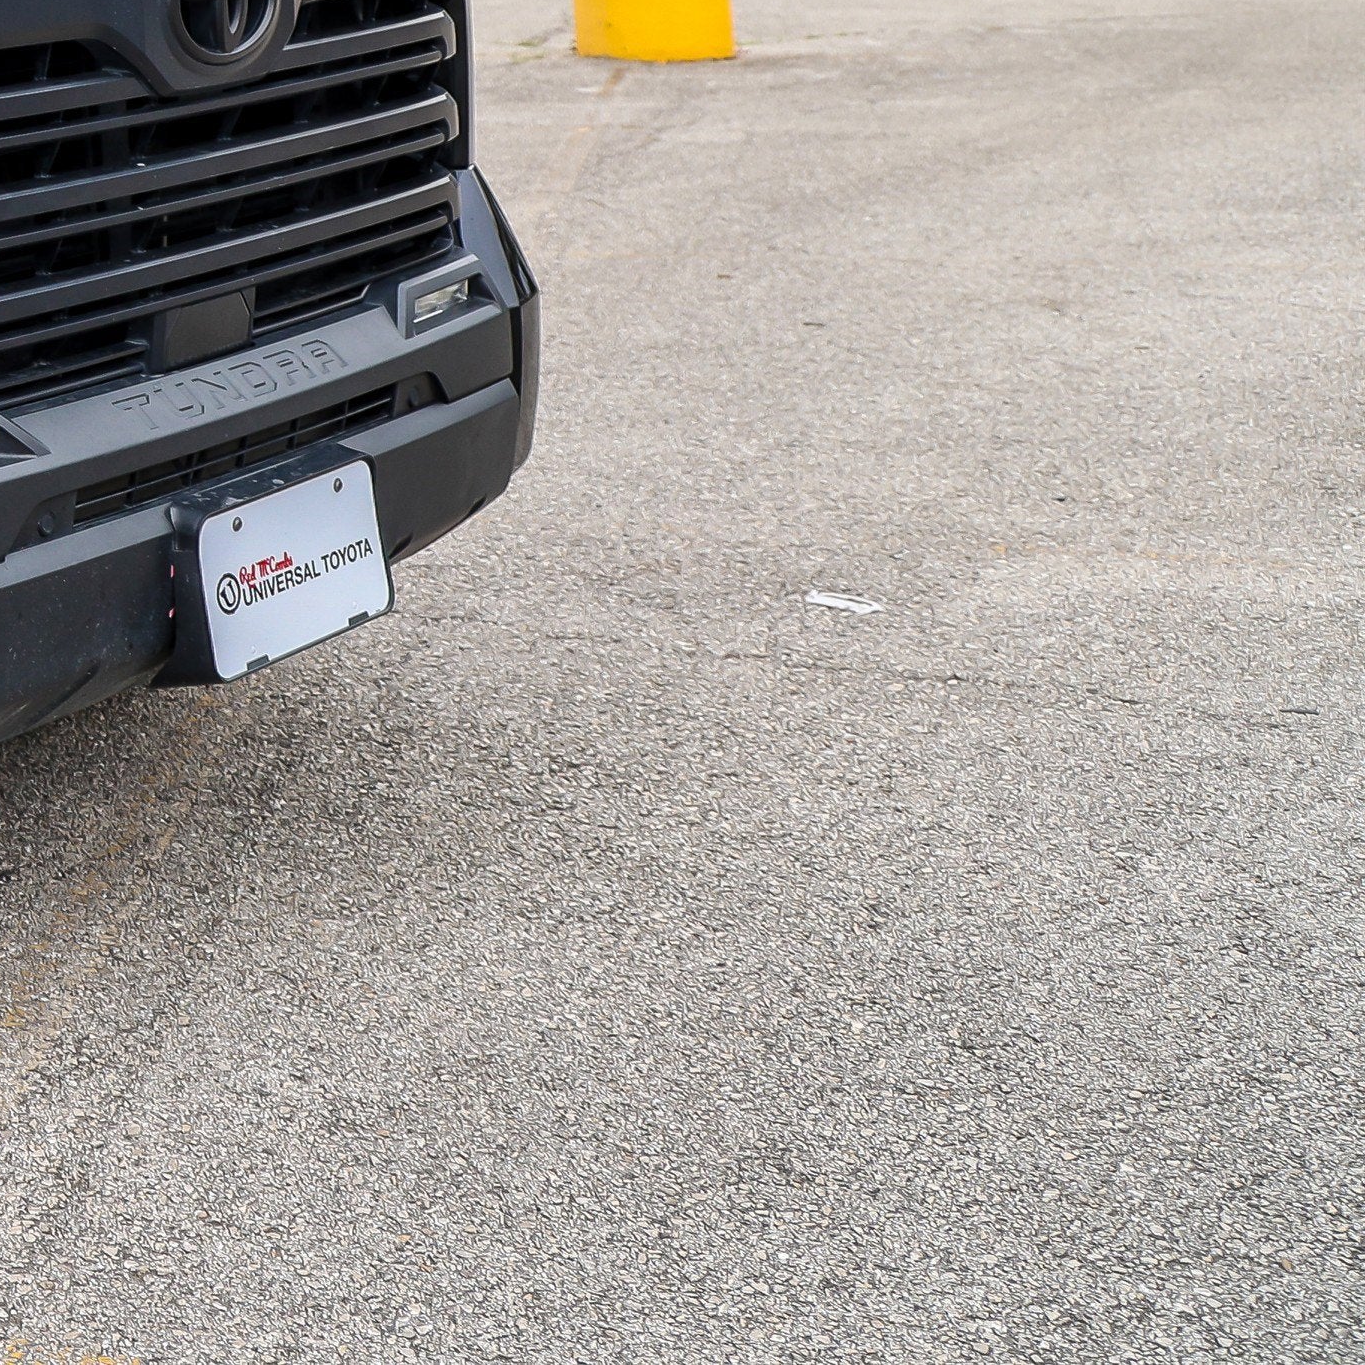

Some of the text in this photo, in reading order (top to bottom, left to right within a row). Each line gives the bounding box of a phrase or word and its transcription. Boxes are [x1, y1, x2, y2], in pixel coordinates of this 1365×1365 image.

[110, 338, 348, 431] TUNDRA
[238, 564, 257, 587] Red
[242, 559, 321, 607] UNIVERSAL
[320, 537, 374, 573] TOYOTA
